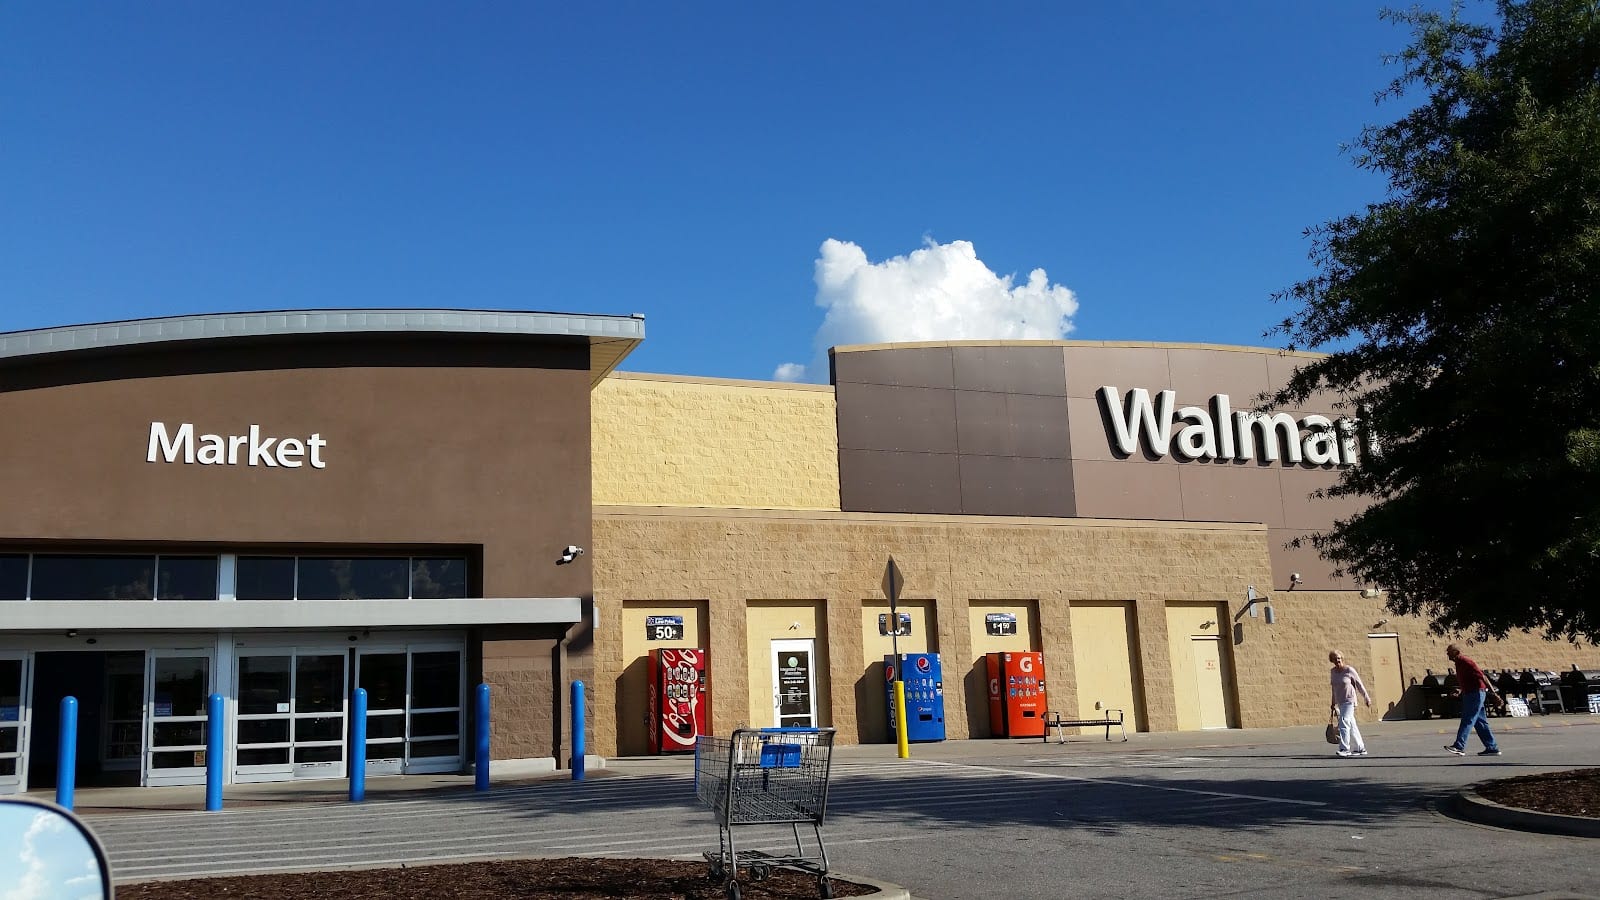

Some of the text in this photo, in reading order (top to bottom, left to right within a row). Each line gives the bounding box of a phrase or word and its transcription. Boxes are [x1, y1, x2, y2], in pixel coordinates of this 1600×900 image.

[147, 422, 327, 469] Market
[1020, 657, 1033, 672] G
[990, 679, 999, 694] G
